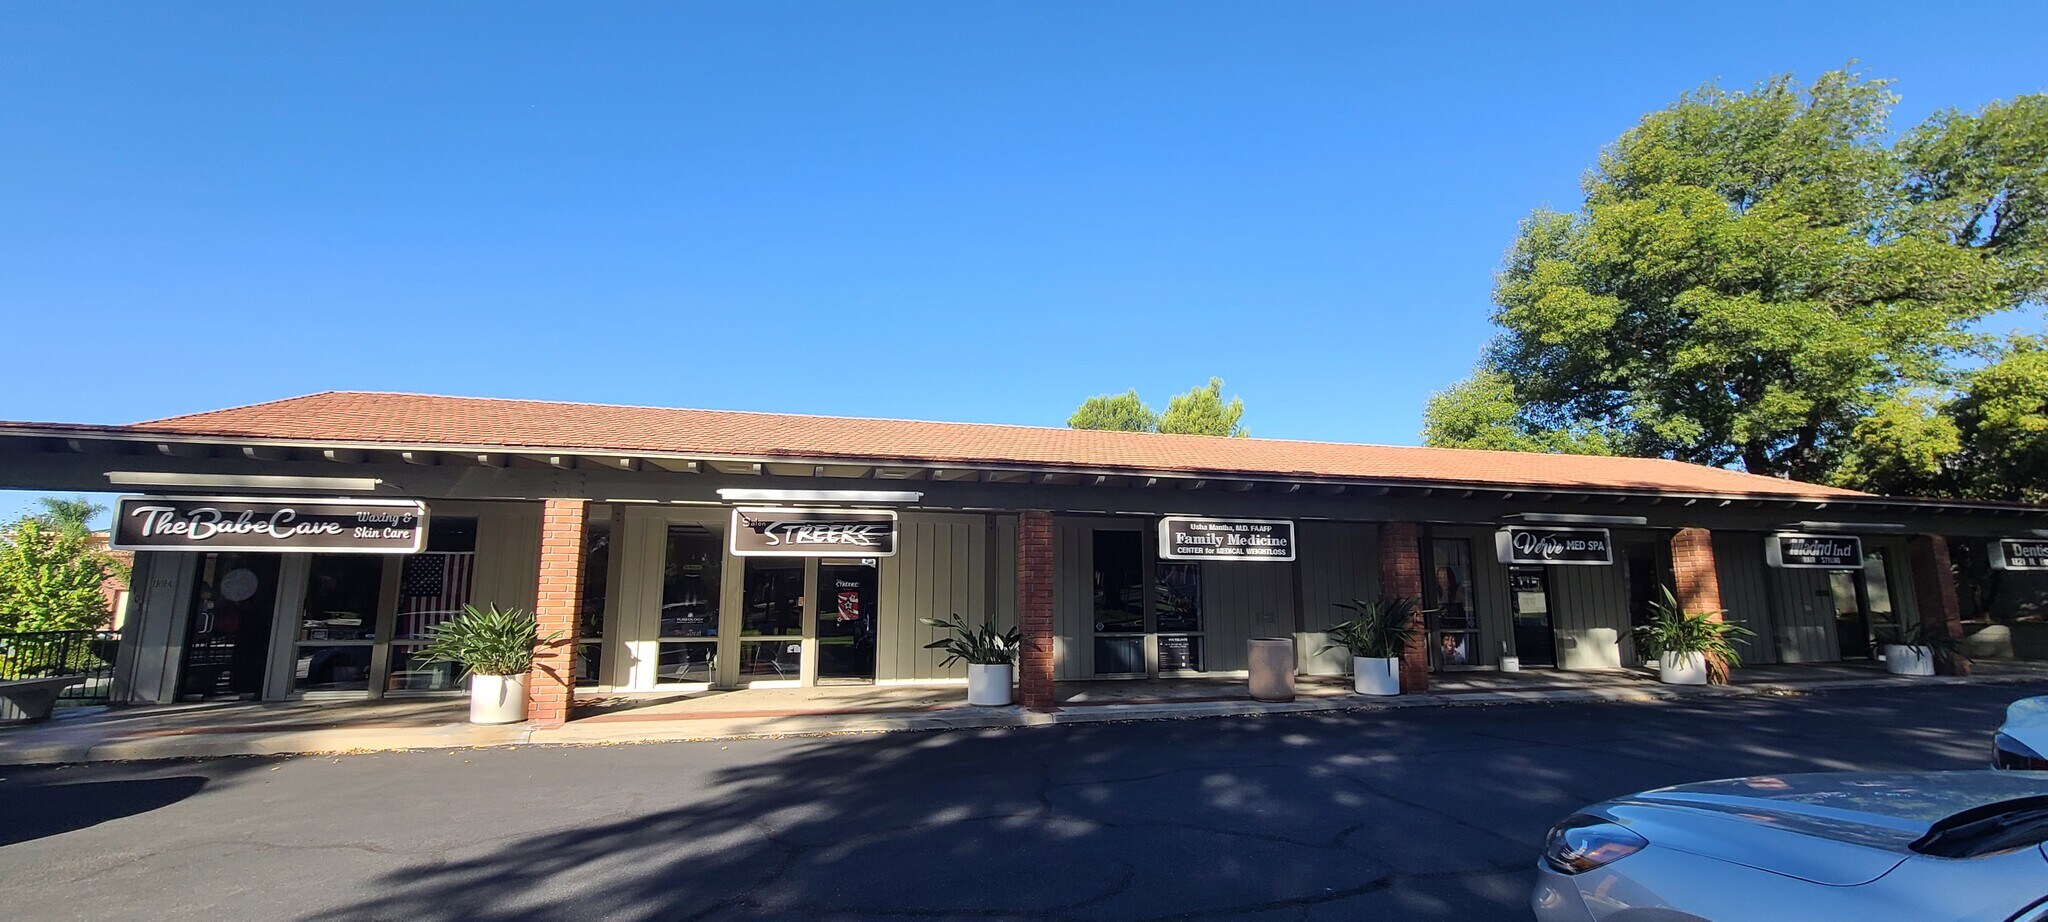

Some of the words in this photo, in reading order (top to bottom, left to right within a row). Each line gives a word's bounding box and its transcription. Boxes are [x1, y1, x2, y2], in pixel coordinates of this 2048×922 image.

[355, 511, 400, 527] Waxing
[402, 511, 413, 524] &
[353, 526, 381, 539] Skin
[383, 526, 411, 540] Care
[764, 519, 890, 547] STREEKS
[1190, 523, 1208, 531] Usha
[1208, 524, 1235, 532] Mantha,
[1175, 532, 1224, 547] Family
[1227, 533, 1288, 547] Medicine
[1513, 532, 1564, 560] Verve
[1566, 540, 1586, 551] MED
[1587, 540, 1606, 551] SPA
[1177, 546, 1204, 554] CENTER
[1216, 547, 1244, 555] MEDICAL
[1246, 547, 1287, 556] WEIGHTLOSS
